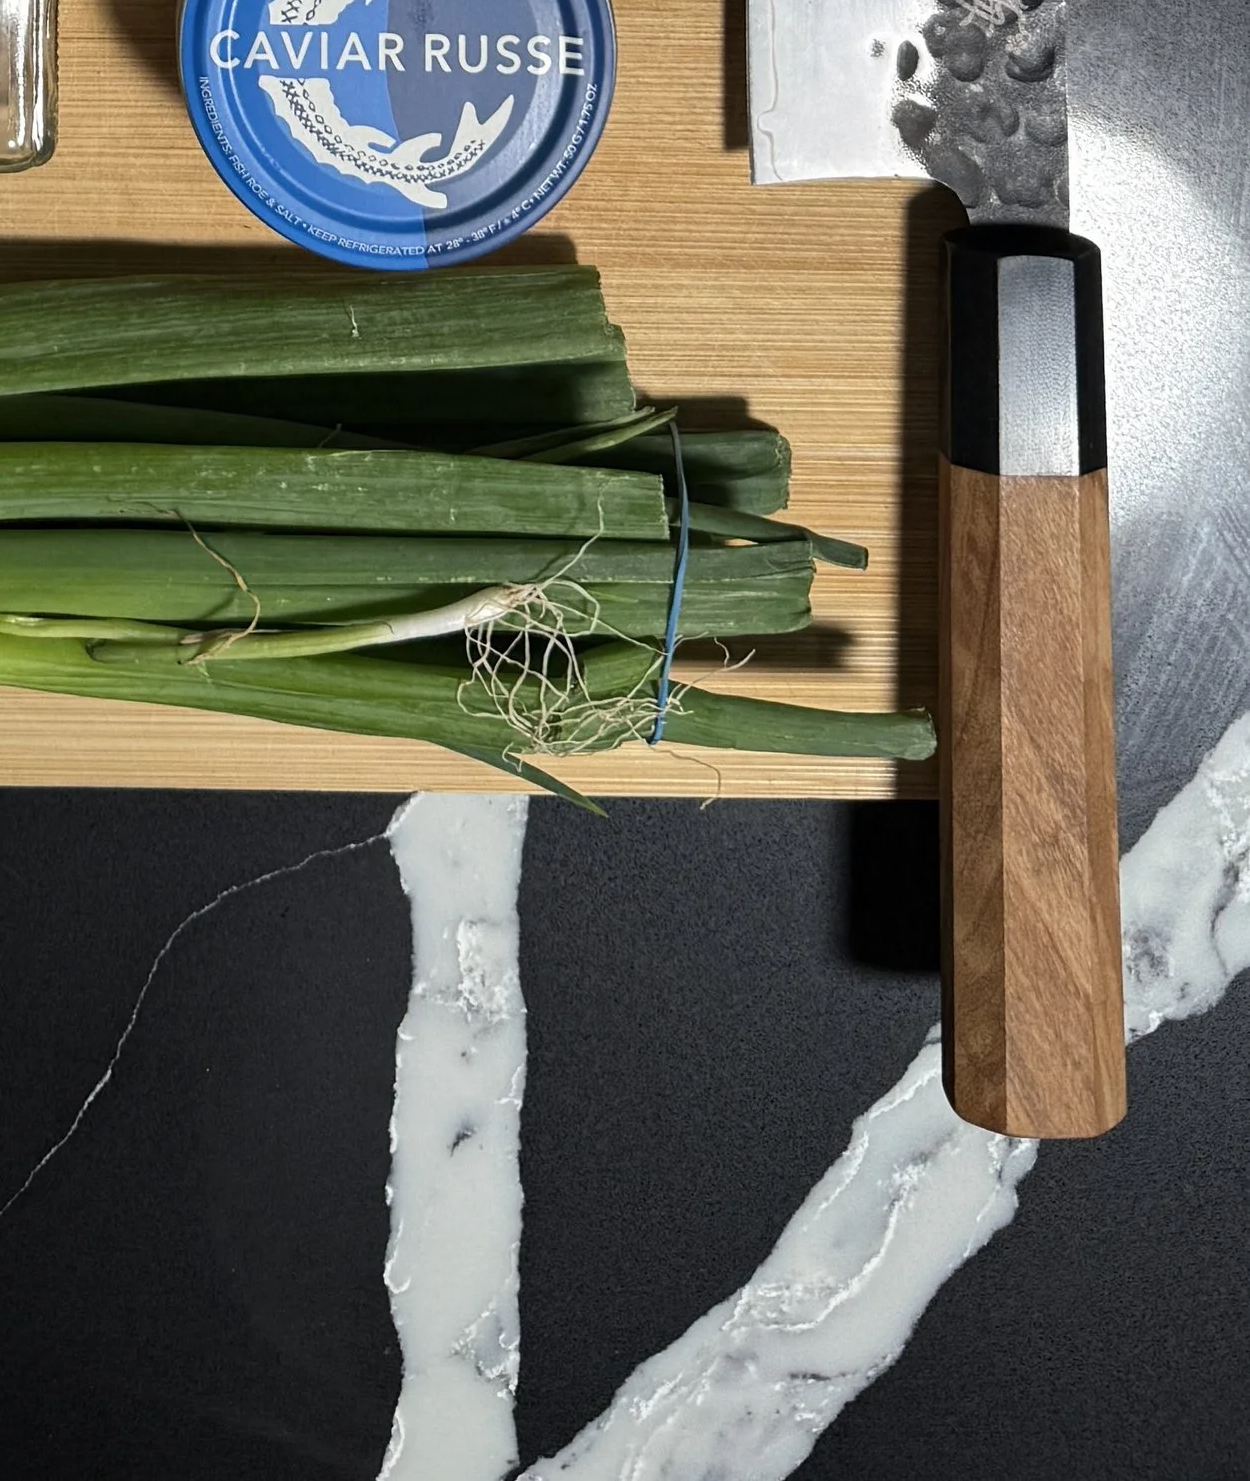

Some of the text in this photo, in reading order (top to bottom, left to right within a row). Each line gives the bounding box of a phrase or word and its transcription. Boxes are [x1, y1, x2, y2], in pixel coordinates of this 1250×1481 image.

[210, 28, 586, 76] CAVIAR RUSSE
[200, 76, 233, 156] INGREDIENTS:
[228, 155, 249, 179] FISH
[246, 178, 269, 200] ROE
[275, 205, 303, 225] SALT
[307, 223, 338, 244] KEEP
[338, 237, 425, 256] REFRIGERATED
[427, 242, 443, 254] AT
[534, 176, 554, 201] NET
[586, 82, 597, 101] OZ
